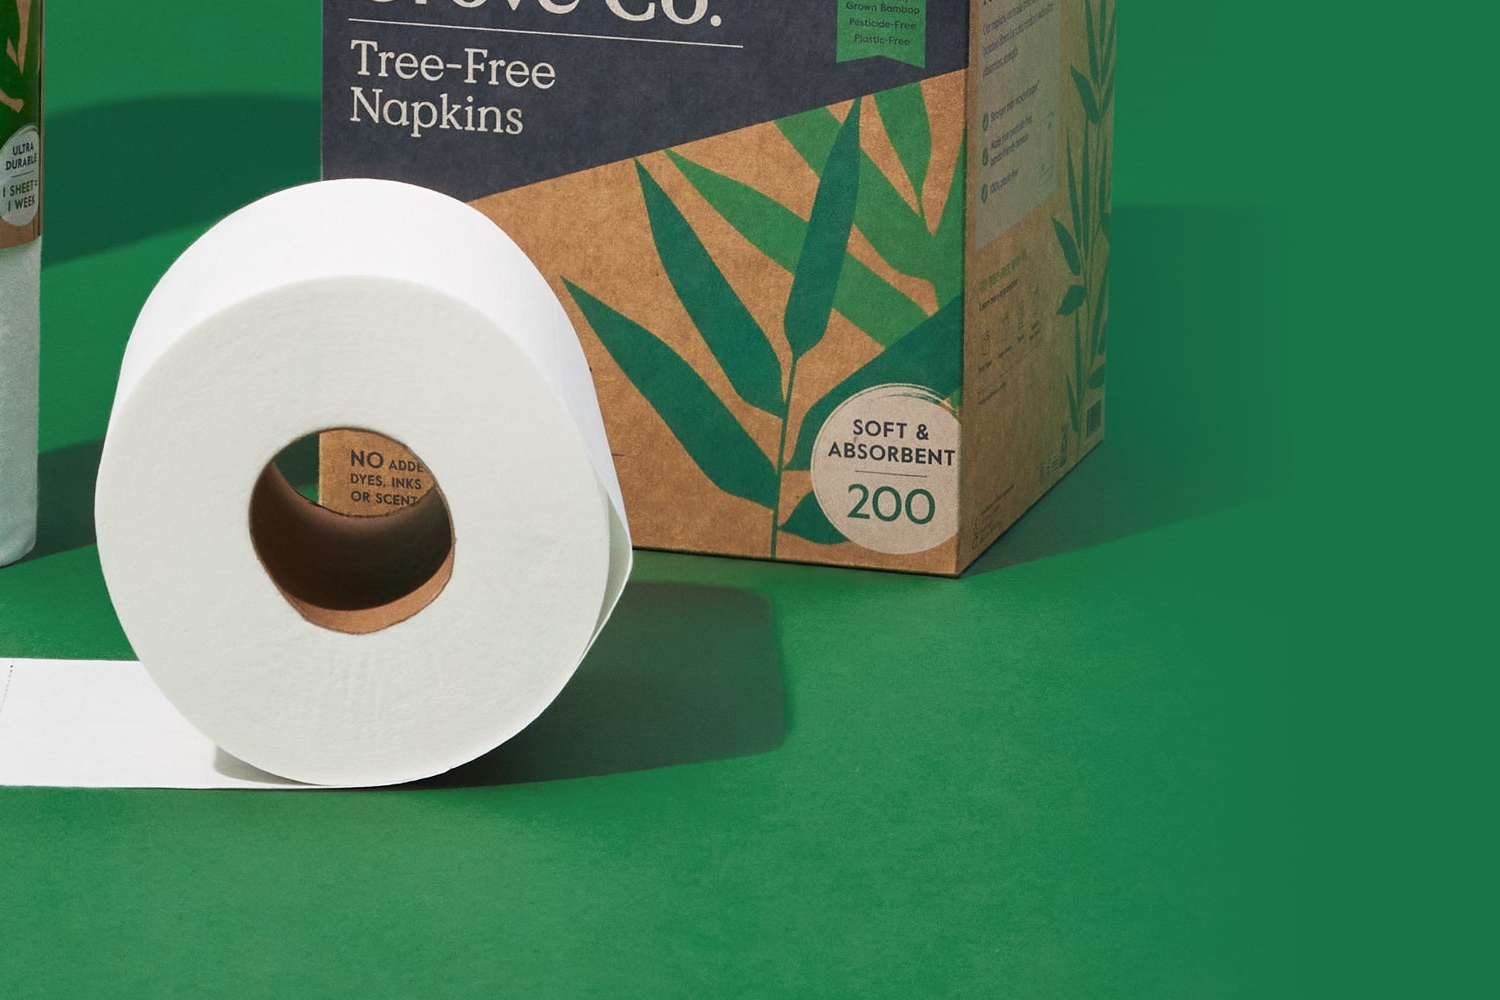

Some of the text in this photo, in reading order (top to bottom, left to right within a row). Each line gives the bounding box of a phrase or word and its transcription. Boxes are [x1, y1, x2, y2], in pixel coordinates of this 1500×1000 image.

[846, 1, 920, 15] Grown Bamboo
[849, 17, 917, 30] Pesticide-Free
[854, 34, 911, 46] Plastic-Free
[350, 39, 556, 90] Tree-Free
[349, 86, 524, 138] Napkins
[12, 142, 34, 156] ULTRA
[5, 153, 37, 170] DURABLE
[15, 195, 35, 210] WEEK
[853, 419, 929, 440] SOFT &
[350, 450, 425, 473] NO ADDE
[828, 441, 956, 466] ABSORBENT
[350, 473, 422, 490] DYES, INKS
[350, 490, 420, 507] OR SCENT
[847, 483, 936, 525] 200
